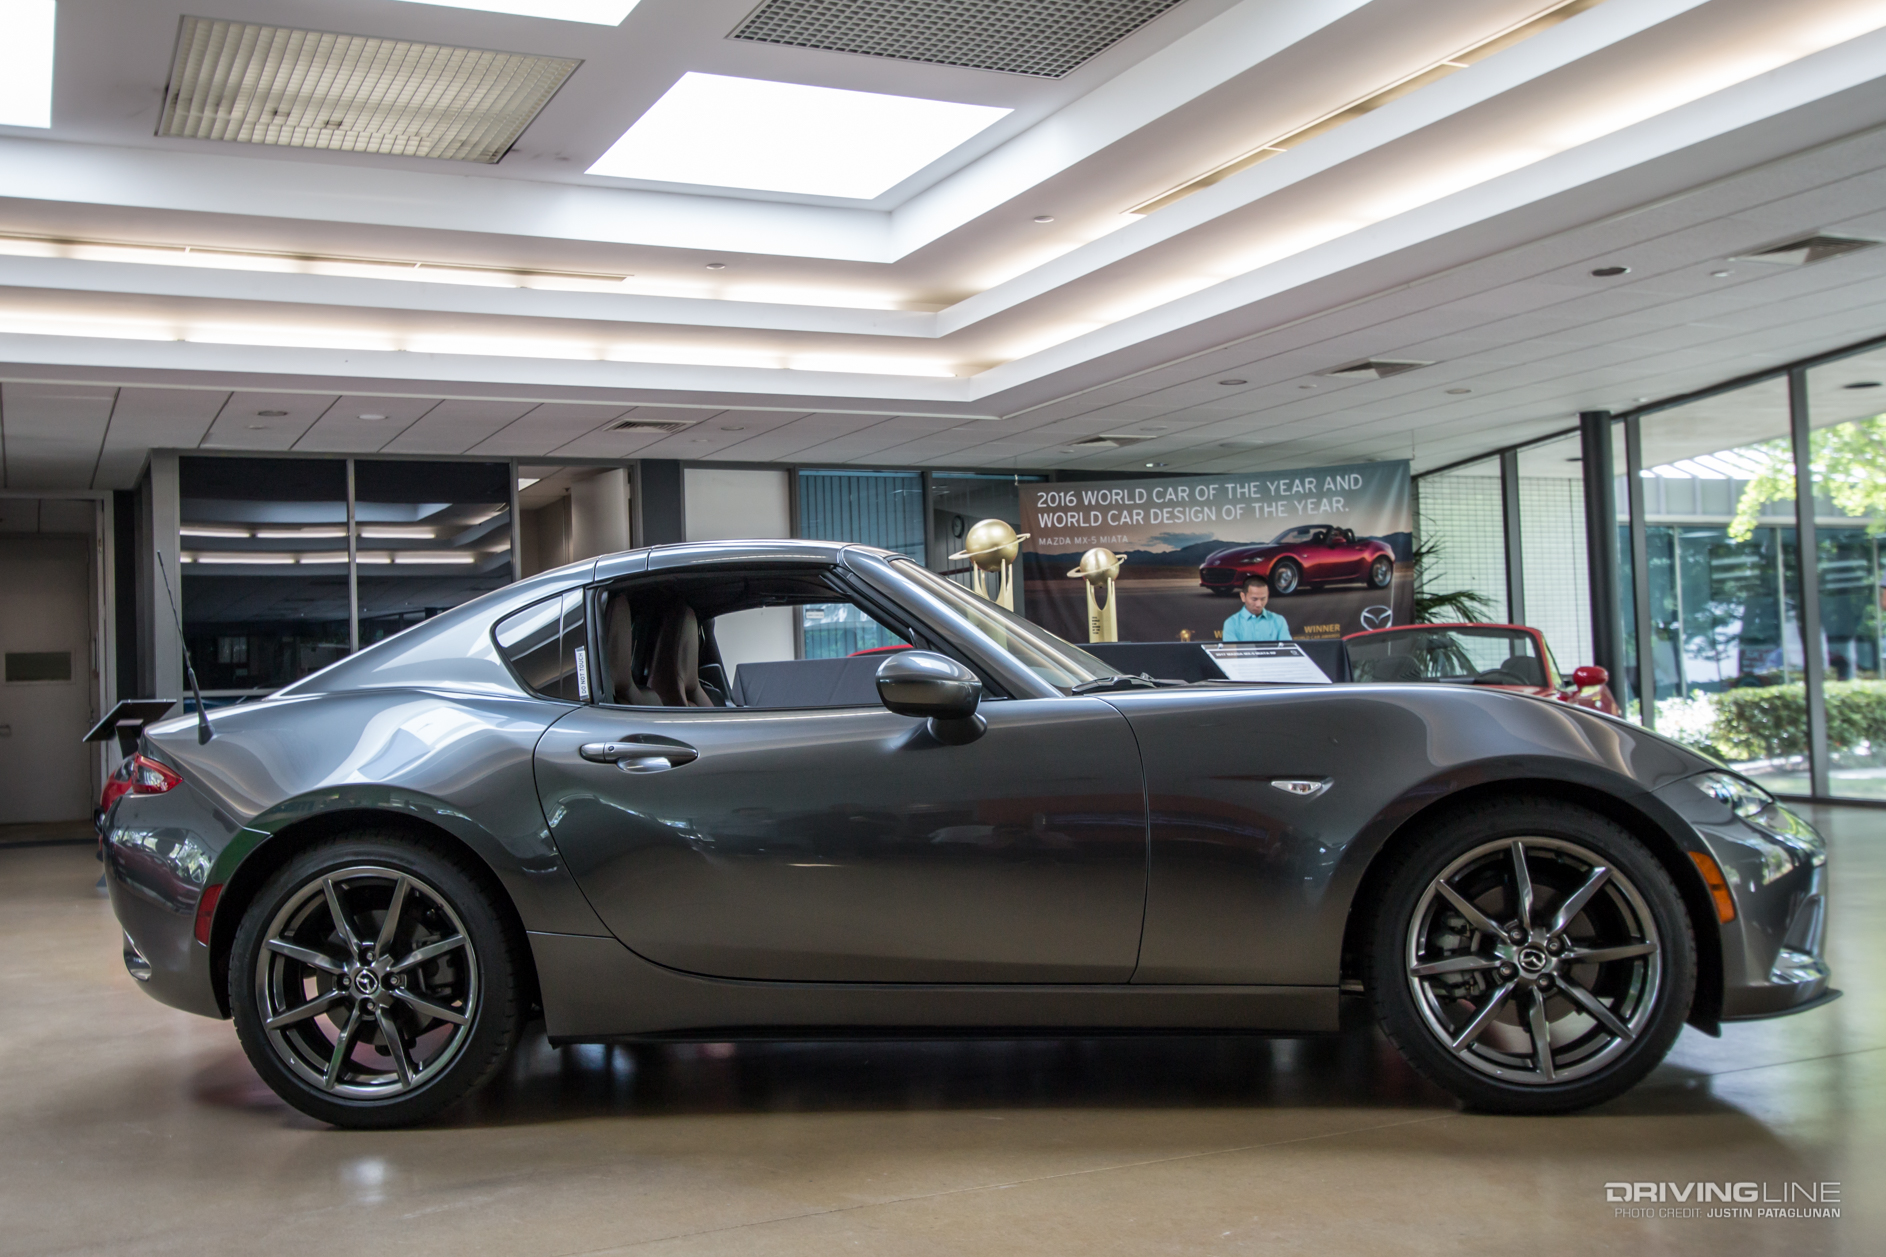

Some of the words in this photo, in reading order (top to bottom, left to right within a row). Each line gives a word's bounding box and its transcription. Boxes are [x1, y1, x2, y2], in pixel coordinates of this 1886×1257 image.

[1037, 491, 1077, 508] 2016
[1082, 488, 1147, 505] WORLD
[1152, 486, 1189, 503] CAR
[1195, 485, 1219, 501] OF
[1224, 482, 1261, 499] THE
[1266, 477, 1317, 496] YEAR
[1323, 474, 1363, 492] AND
[1038, 511, 1102, 528] WORLD
[1107, 509, 1144, 526] CAR
[1150, 506, 1216, 524] DESIGN
[1222, 504, 1246, 520] OF
[1252, 501, 1288, 518] THE
[1294, 497, 1349, 515] YEAR.
[1038, 537, 1071, 546] MAZDA
[1074, 536, 1097, 545] MX-5
[1100, 535, 1128, 544] MIATA
[1304, 623, 1340, 633] WINNER
[581, 686, 587, 694] DO
